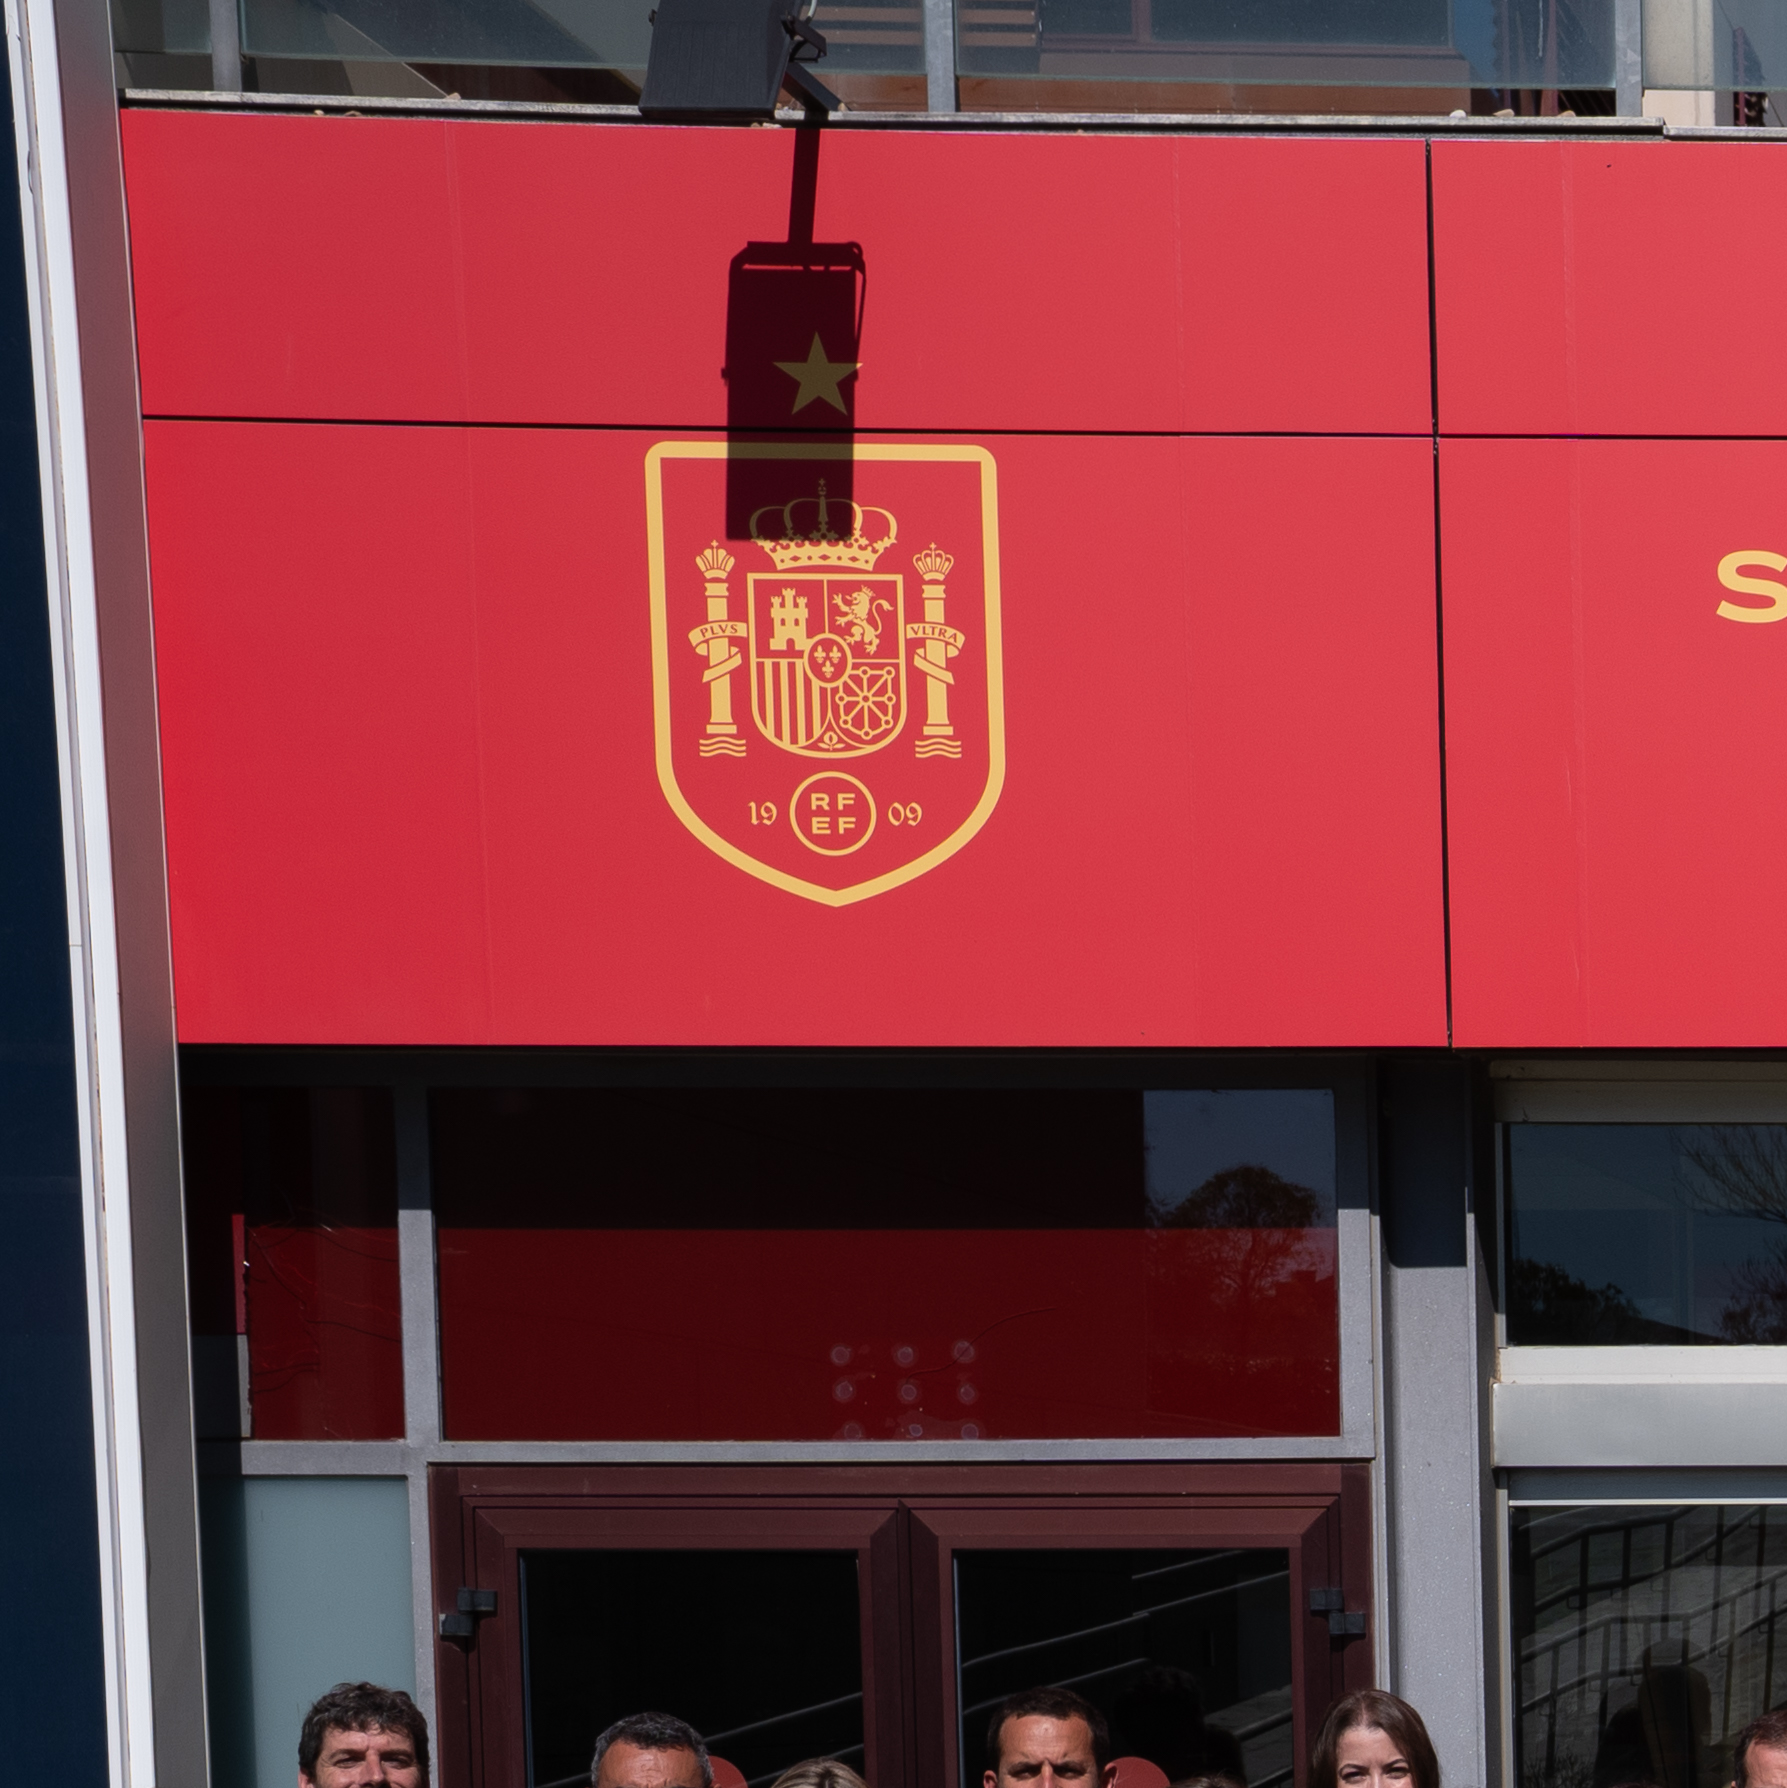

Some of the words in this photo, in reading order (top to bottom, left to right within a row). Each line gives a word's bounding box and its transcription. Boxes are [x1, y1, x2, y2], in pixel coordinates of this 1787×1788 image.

[699, 623, 738, 638] PLVS
[910, 625, 957, 643] VLTRA
[748, 801, 778, 826] 19
[887, 801, 923, 827] 09
